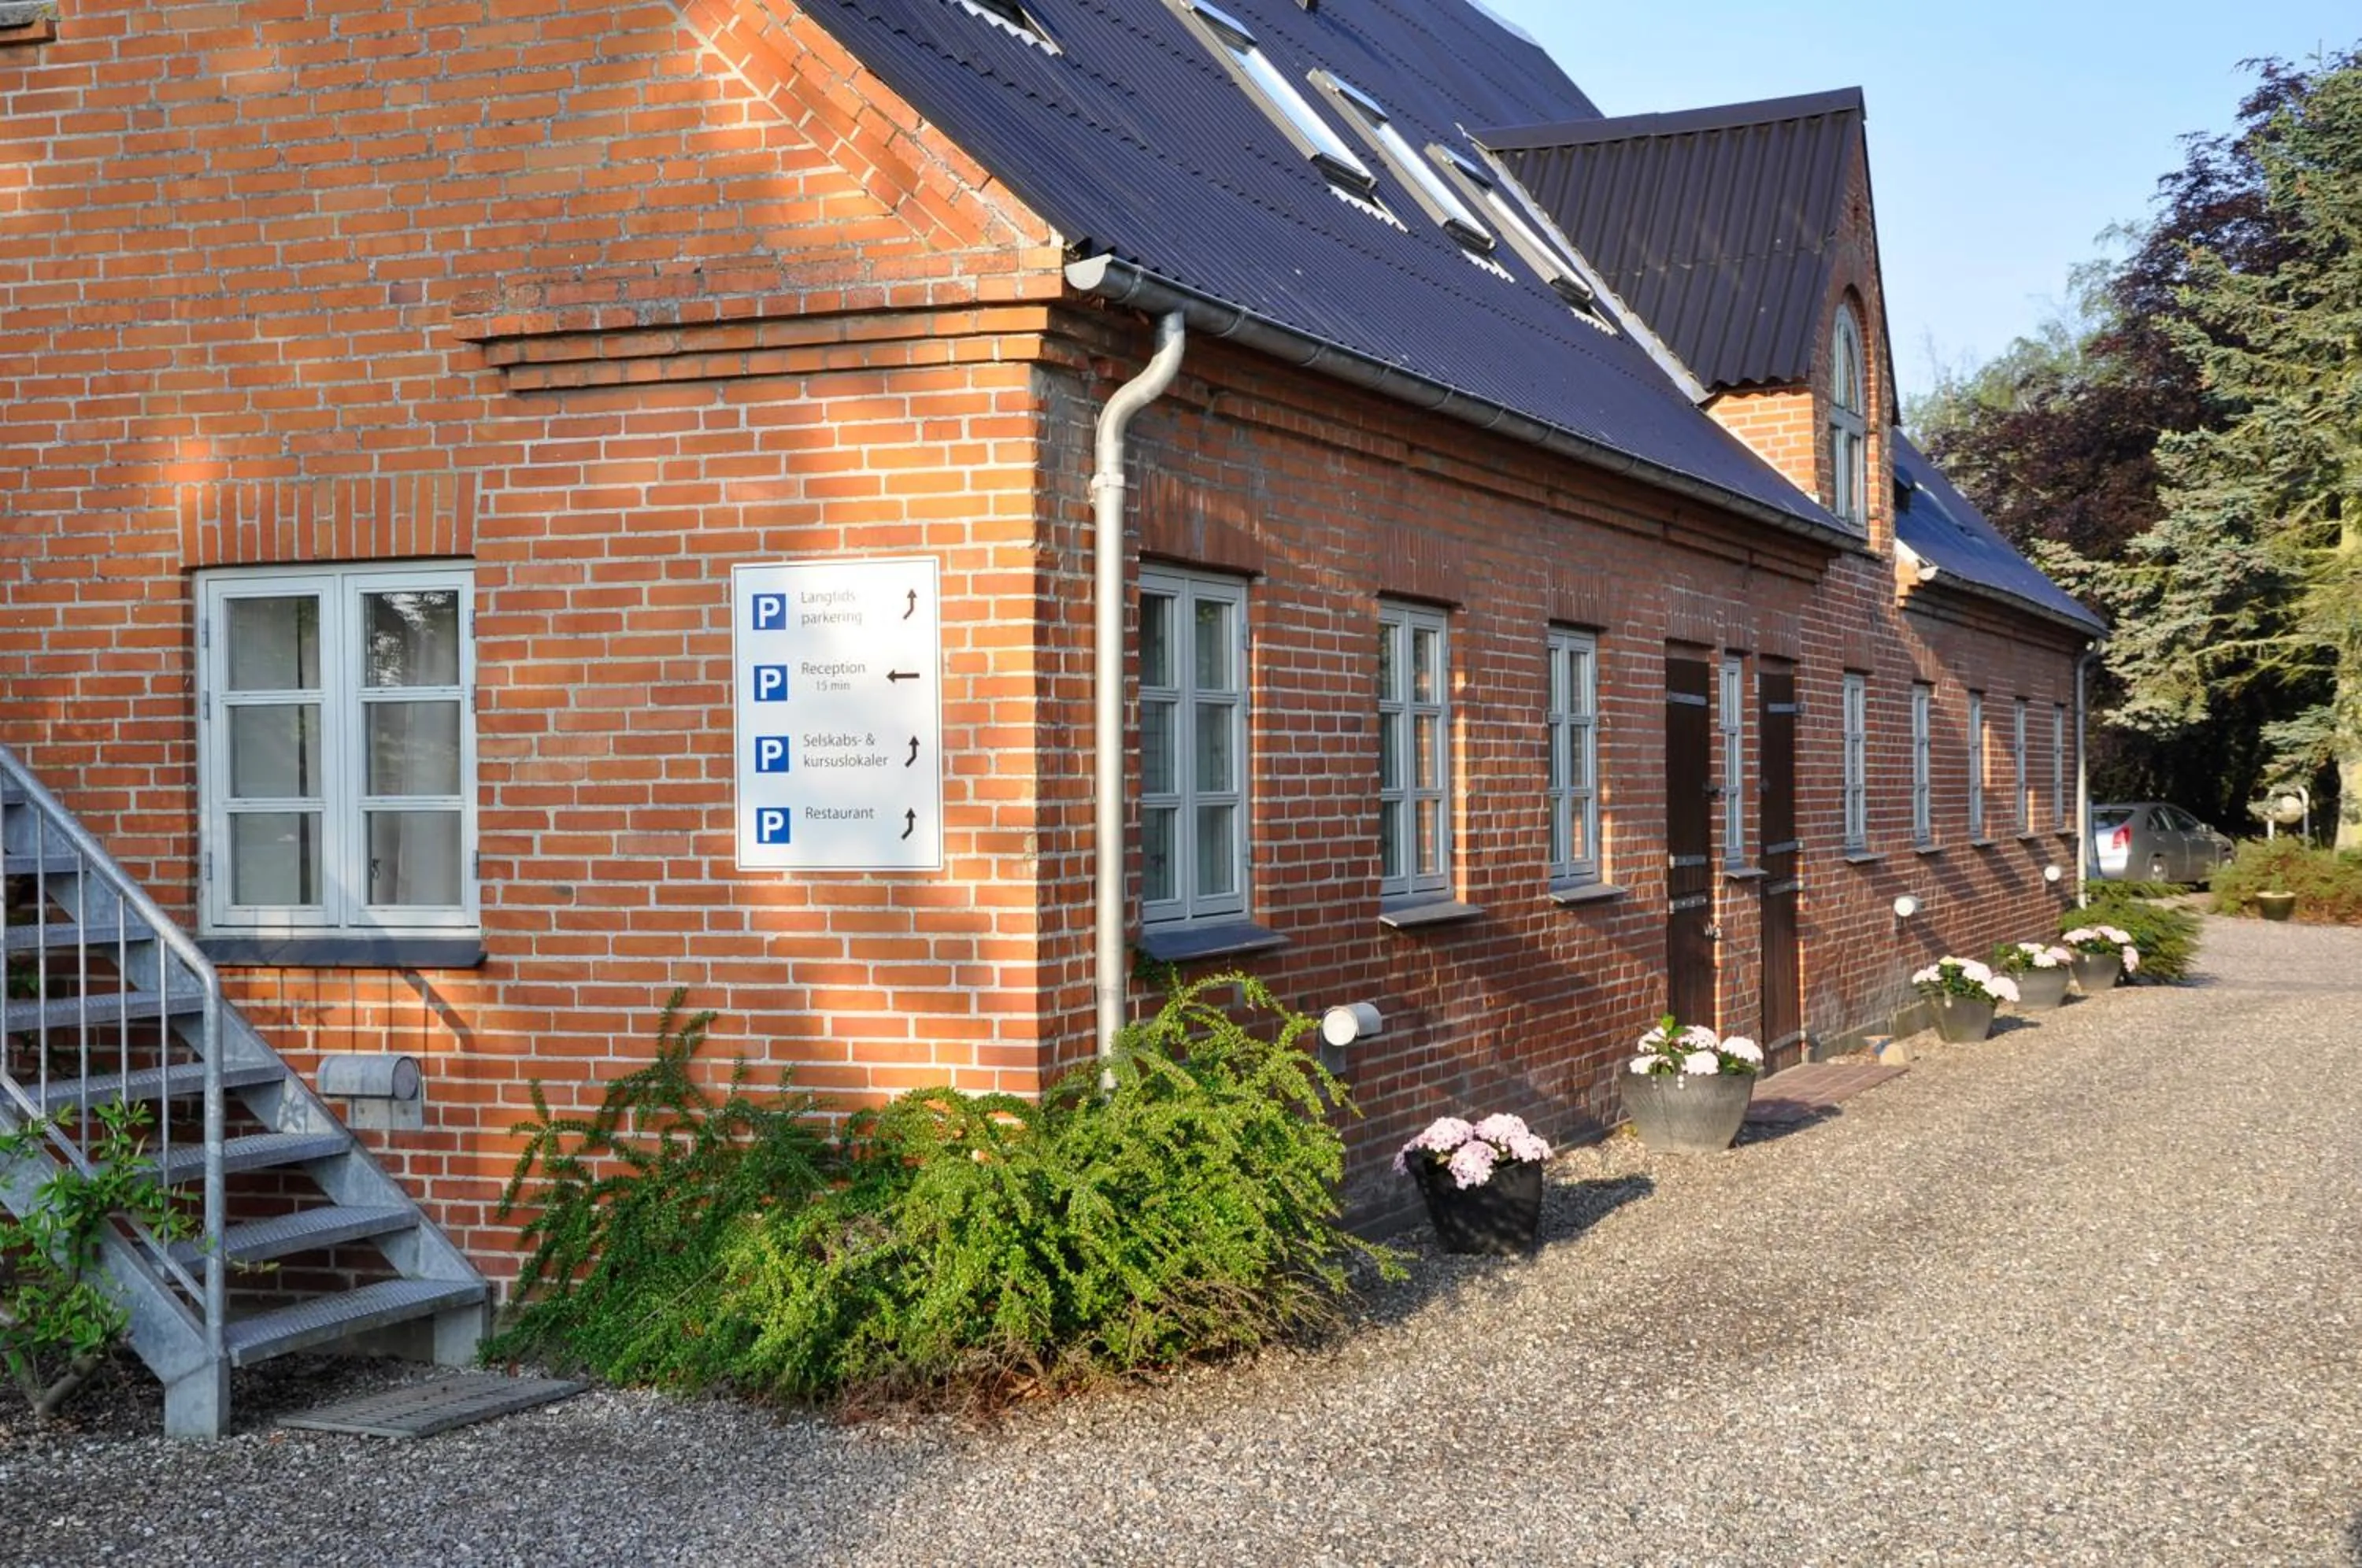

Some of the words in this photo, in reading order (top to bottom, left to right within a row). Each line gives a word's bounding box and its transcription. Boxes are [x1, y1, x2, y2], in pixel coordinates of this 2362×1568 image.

[758, 597, 780, 628] P
[801, 611, 862, 627] parkering
[801, 661, 866, 677] Reception
[760, 669, 782, 700] P
[816, 680, 827, 691] 15
[831, 681, 850, 690] min
[803, 733, 862, 747] Selskabs-
[865, 732, 876, 745] &
[761, 740, 783, 771] P
[803, 753, 888, 767] kursuslokaler
[805, 806, 875, 819] Restaurant
[763, 811, 784, 842] P
